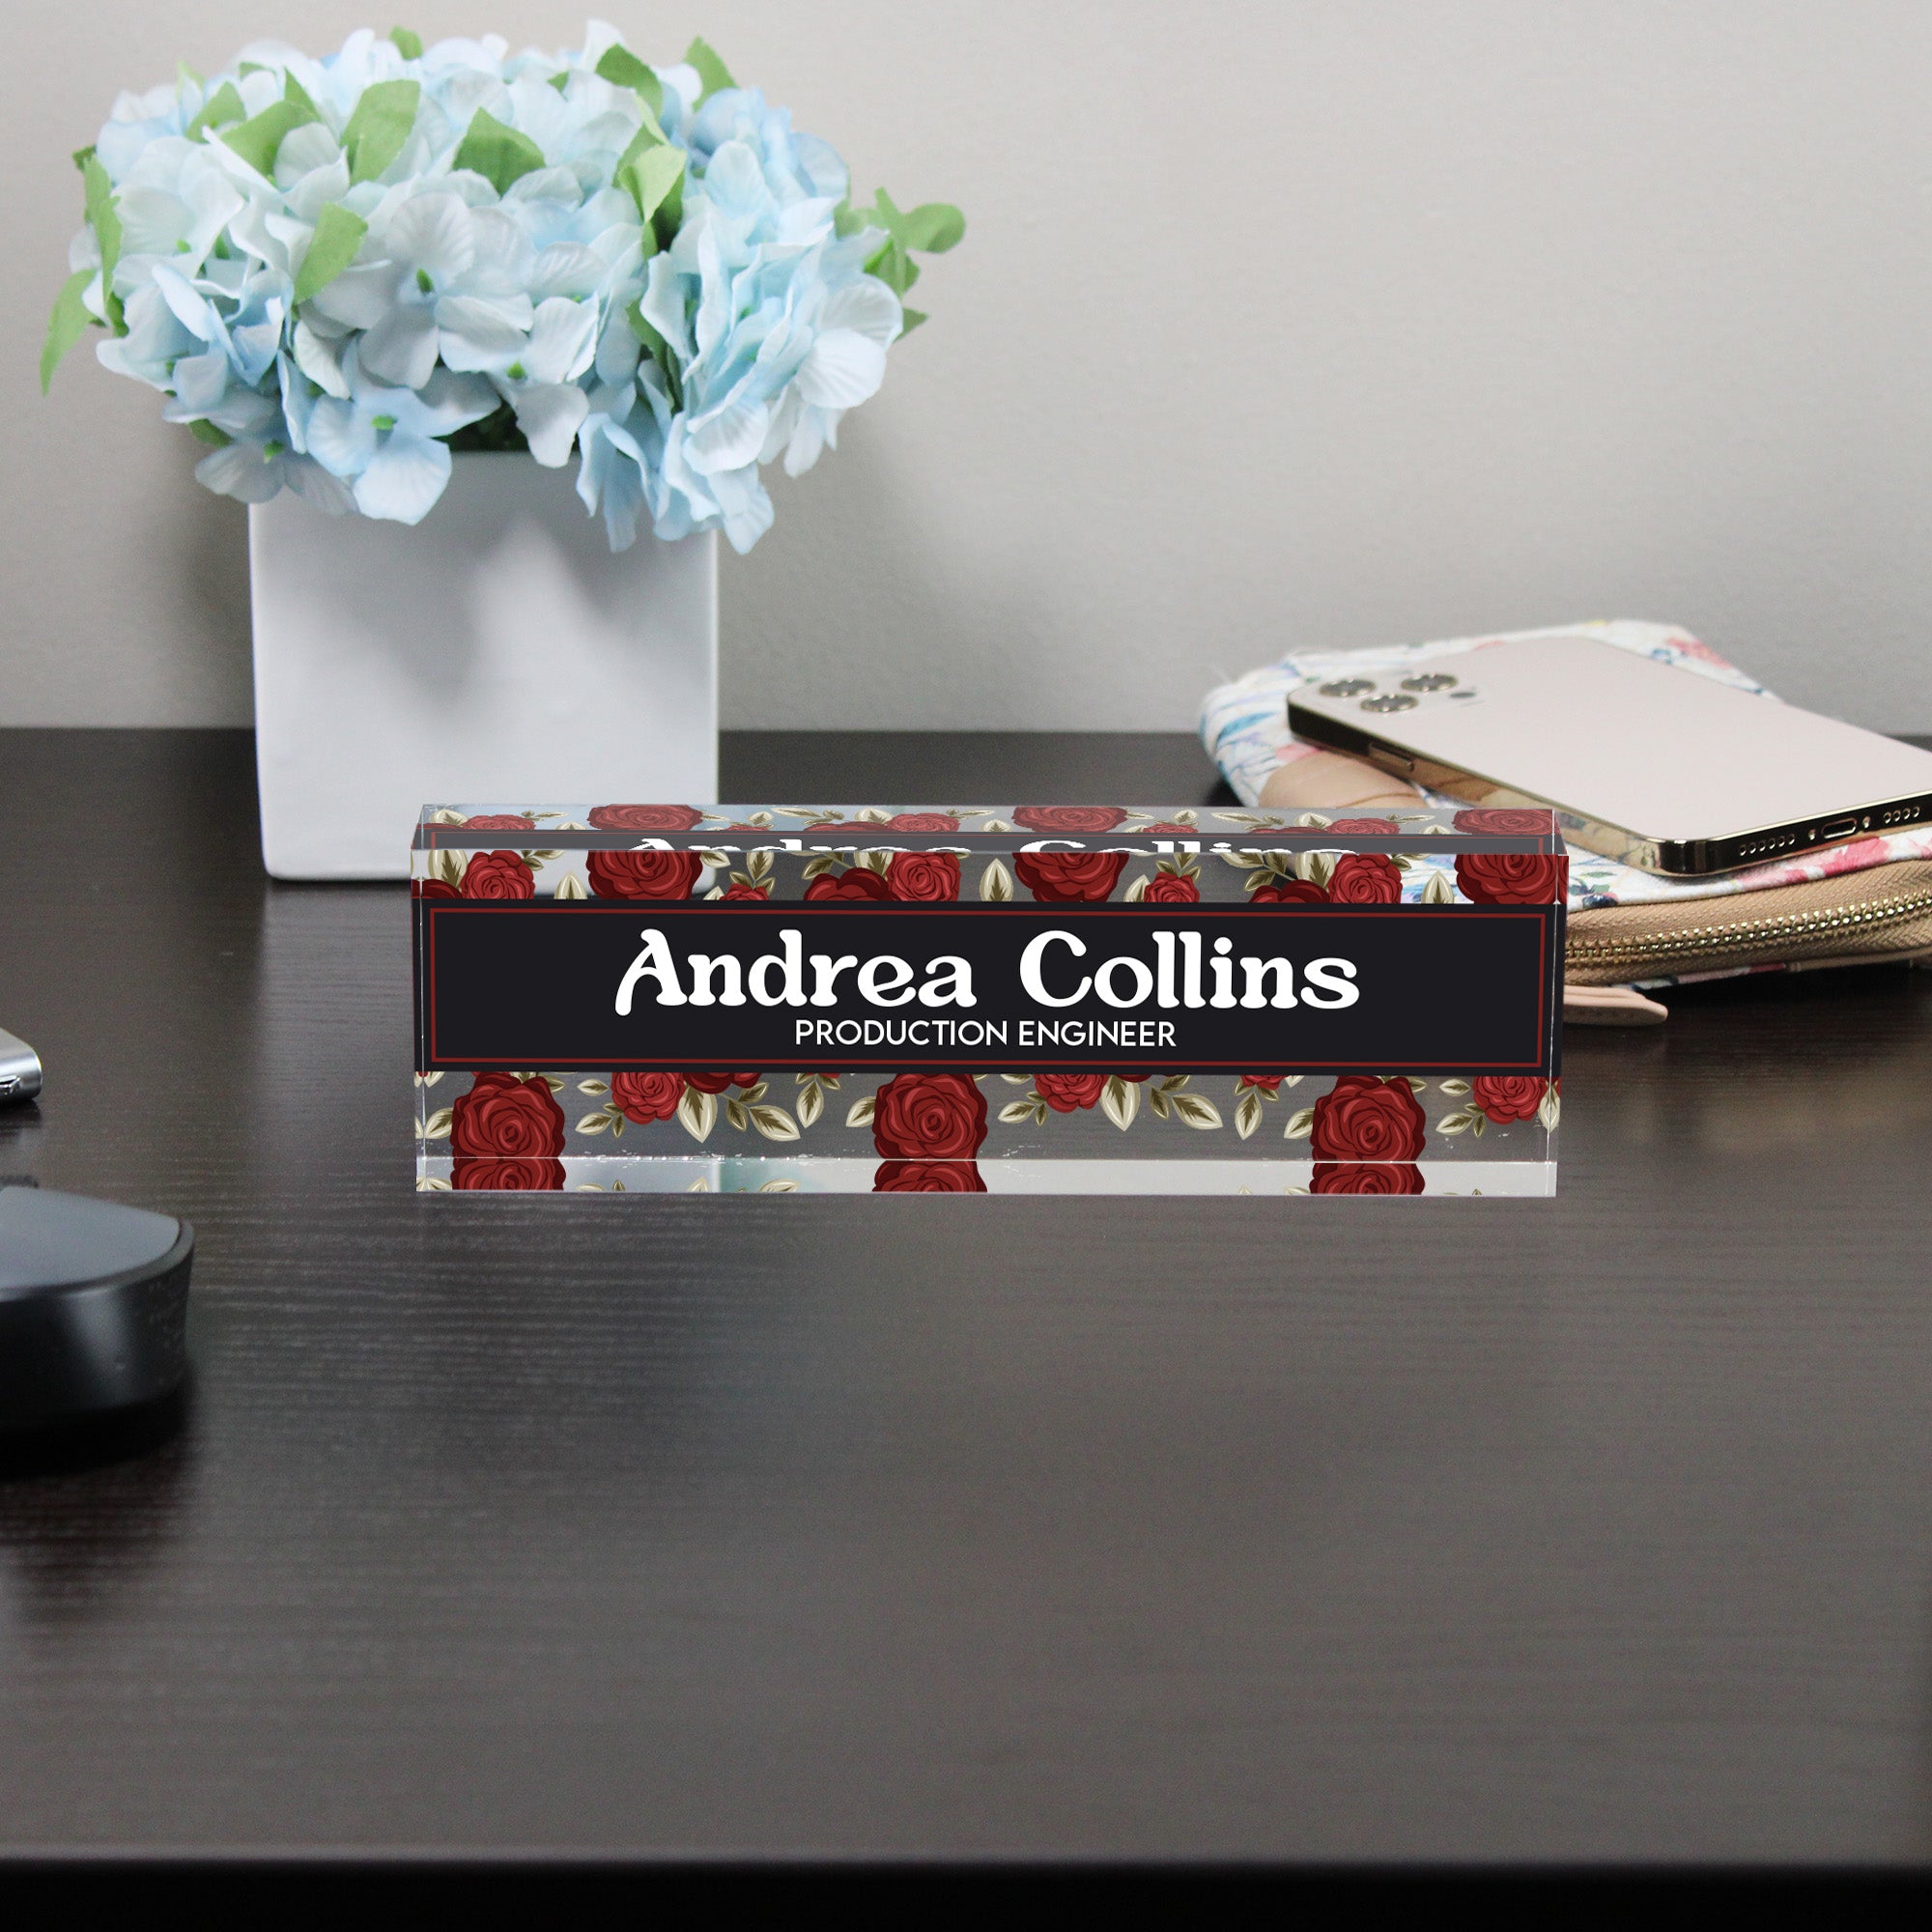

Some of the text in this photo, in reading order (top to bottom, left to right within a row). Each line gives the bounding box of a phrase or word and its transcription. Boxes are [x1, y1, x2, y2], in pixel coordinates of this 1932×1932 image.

[615, 929, 1359, 1015] Andrea Collins
[796, 1020, 1176, 1046] PRODUCTION ENGINEER
